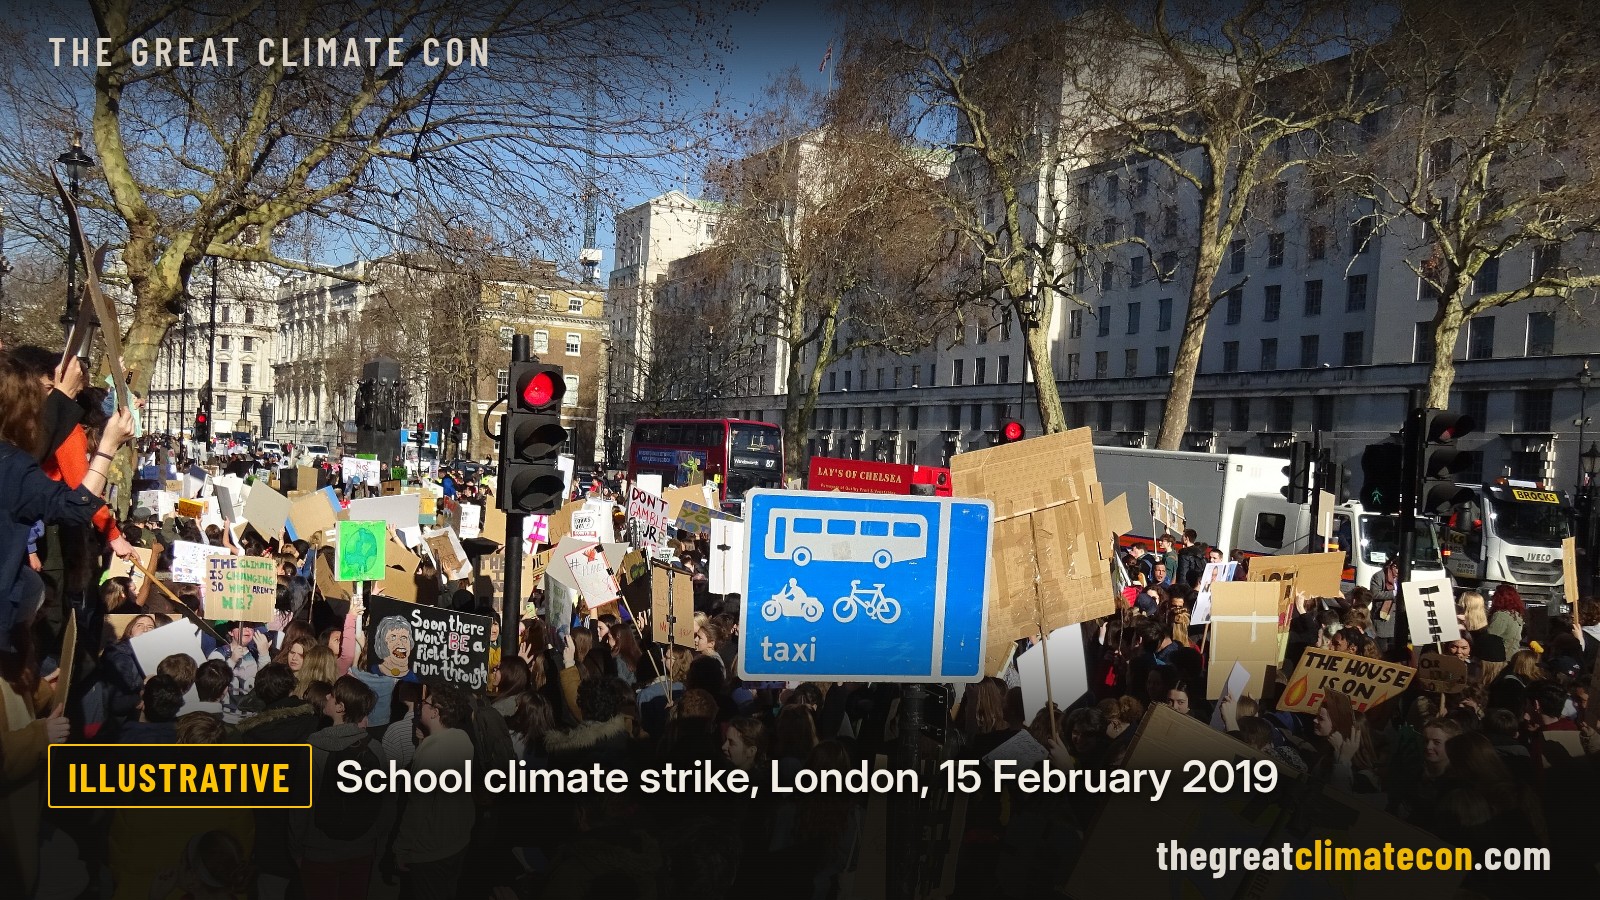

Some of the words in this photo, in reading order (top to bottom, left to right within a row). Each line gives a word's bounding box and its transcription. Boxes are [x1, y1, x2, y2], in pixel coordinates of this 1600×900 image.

[765, 459, 775, 468] 87
[817, 466, 843, 478] LAY'S
[845, 470, 858, 479] OF
[859, 471, 902, 484] CHELSEA
[632, 487, 668, 513] DON'T
[1516, 490, 1556, 502] BROCKS
[630, 501, 667, 532] GAMBLE
[210, 559, 238, 569] THE
[239, 559, 273, 570] CLIMATE
[1527, 552, 1551, 561] IVECO
[209, 570, 223, 580] IS
[226, 571, 273, 585] CHANGING
[211, 581, 224, 592] SO
[229, 584, 251, 594] WHY
[222, 594, 254, 610] WE?
[411, 609, 447, 632] Soon
[449, 615, 485, 636] there
[415, 629, 447, 646] Won't
[449, 632, 470, 653] BE
[473, 641, 486, 653] a
[760, 635, 817, 662] taxi
[417, 644, 450, 661] Field
[451, 650, 470, 665] to
[413, 661, 440, 676] run
[440, 660, 488, 690] through
[1305, 652, 1342, 672] THE
[1343, 658, 1412, 688] HOUSE
[1318, 675, 1340, 690] IS
[1341, 681, 1376, 700] ON
